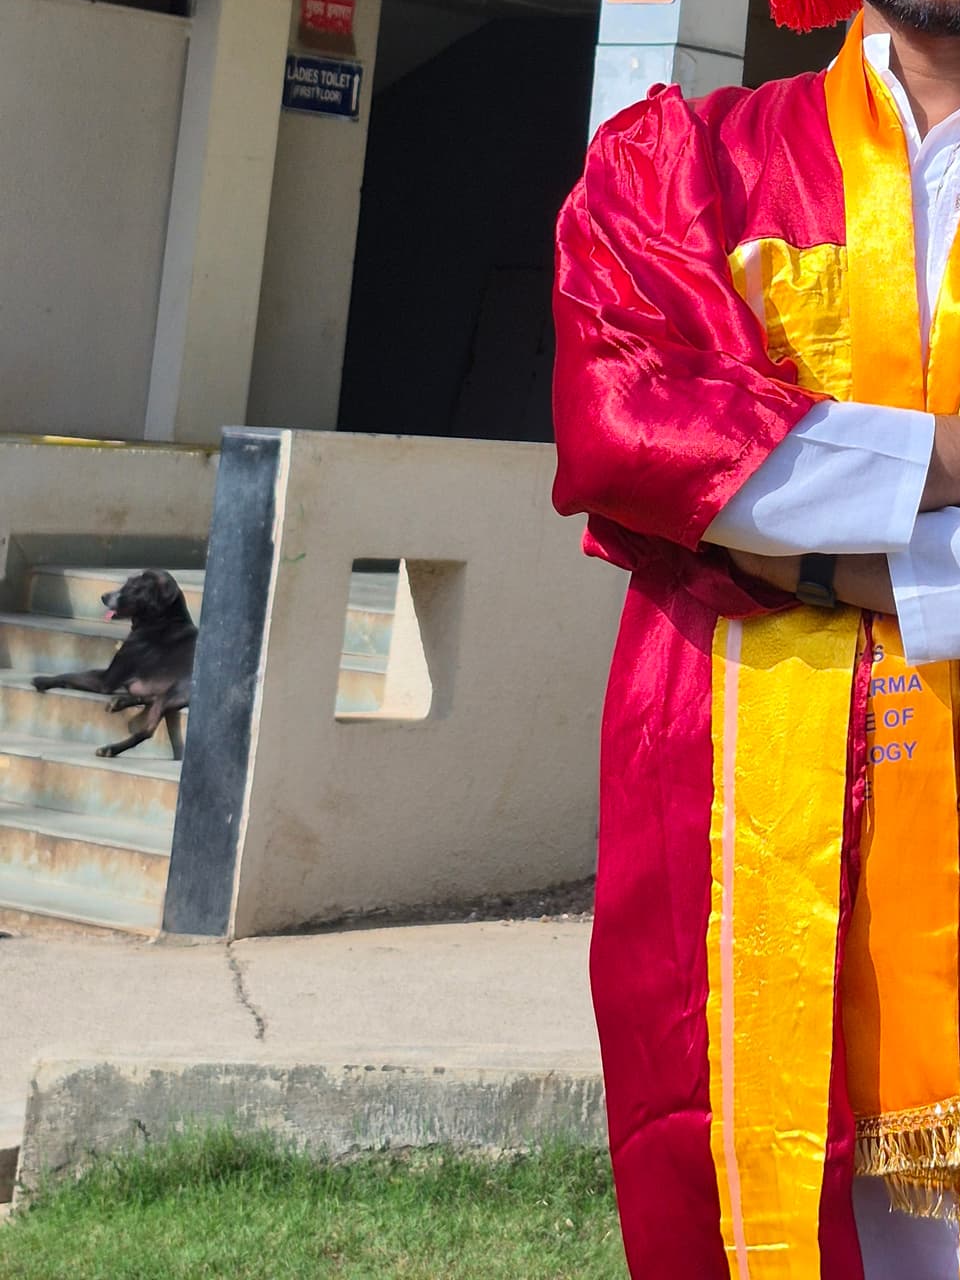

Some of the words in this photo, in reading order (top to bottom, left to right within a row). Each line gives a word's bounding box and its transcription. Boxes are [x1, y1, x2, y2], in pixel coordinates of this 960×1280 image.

[287, 64, 319, 84] LADIES
[320, 69, 351, 89] TOILET
[869, 674, 922, 697] RMA
[884, 707, 914, 729] OF
[867, 741, 917, 765] OGY
